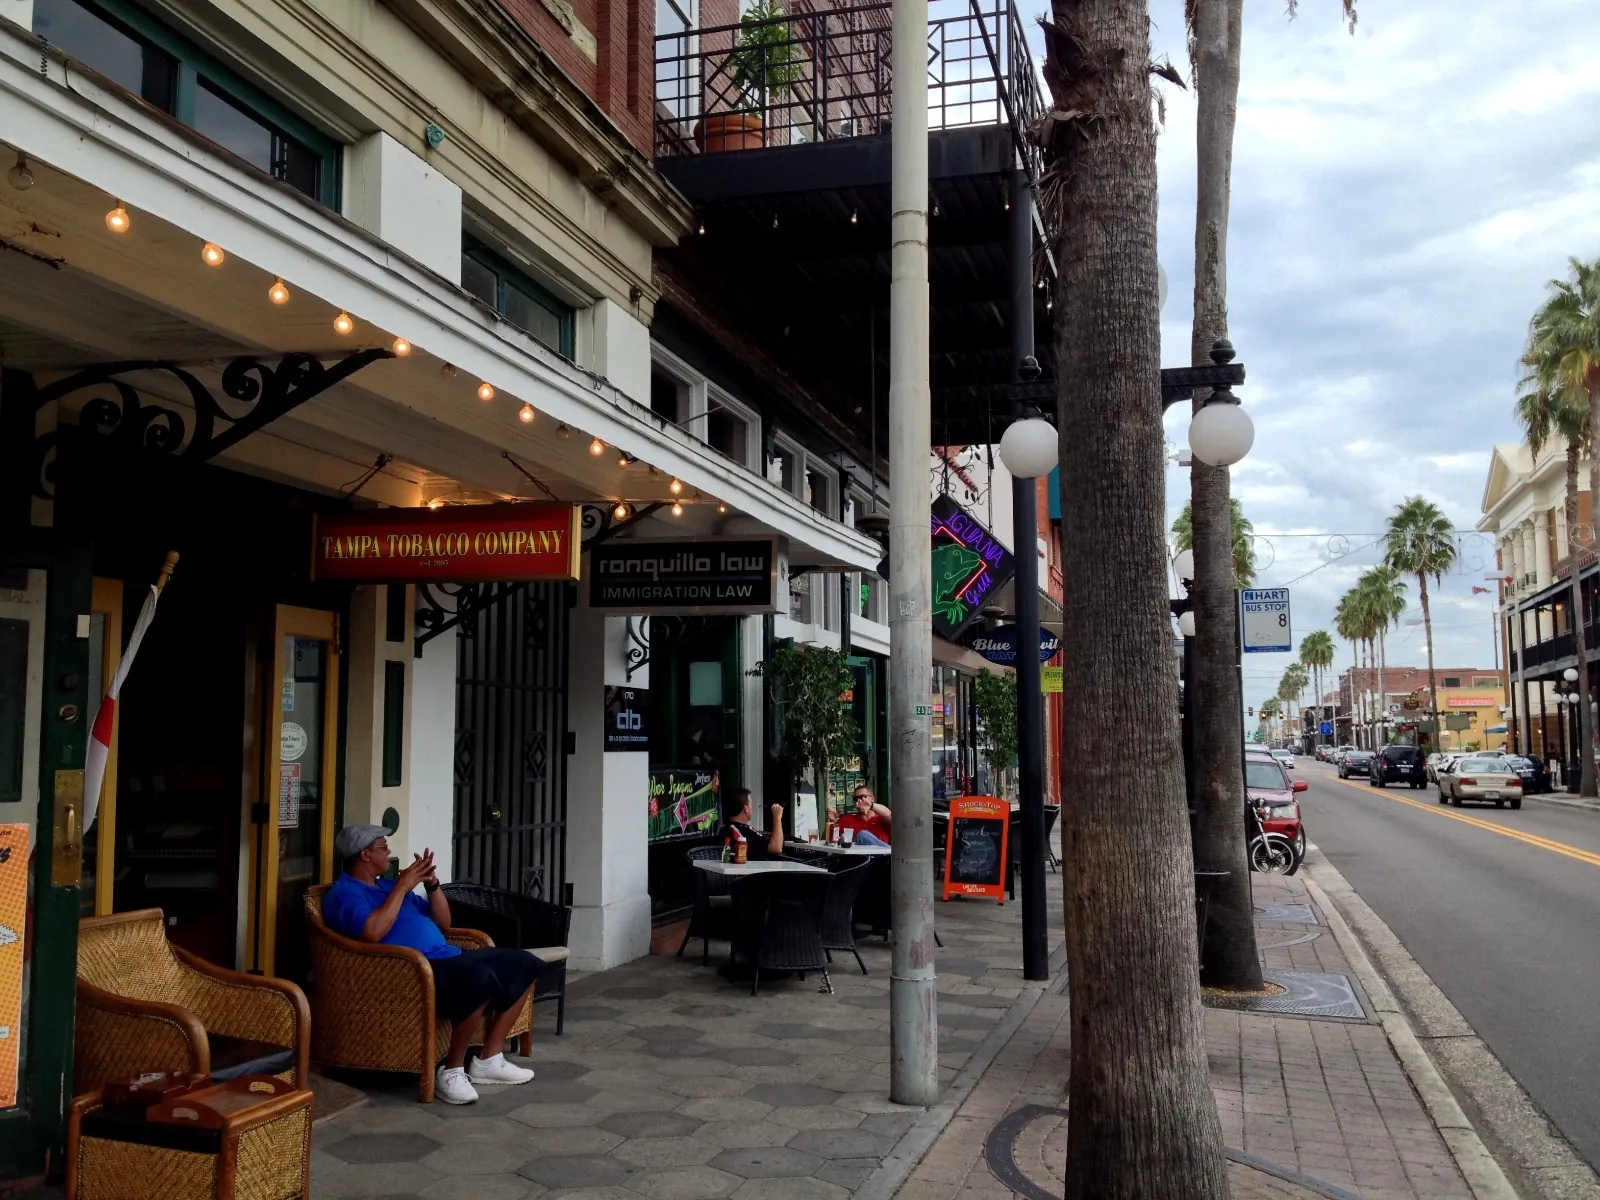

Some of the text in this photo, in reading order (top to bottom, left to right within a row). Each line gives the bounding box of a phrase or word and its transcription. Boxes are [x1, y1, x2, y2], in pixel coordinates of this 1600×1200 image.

[322, 529, 564, 559] TAMPA TOBACCO COMPANY
[945, 508, 1004, 568] IGUANA
[720, 552, 764, 572] law
[603, 585, 753, 599] IMMIGRATION LAW
[1256, 591, 1286, 600] HART
[1279, 613, 1286, 627] 8
[972, 638, 1012, 651] Blue
[986, 651, 1050, 660] TATO
